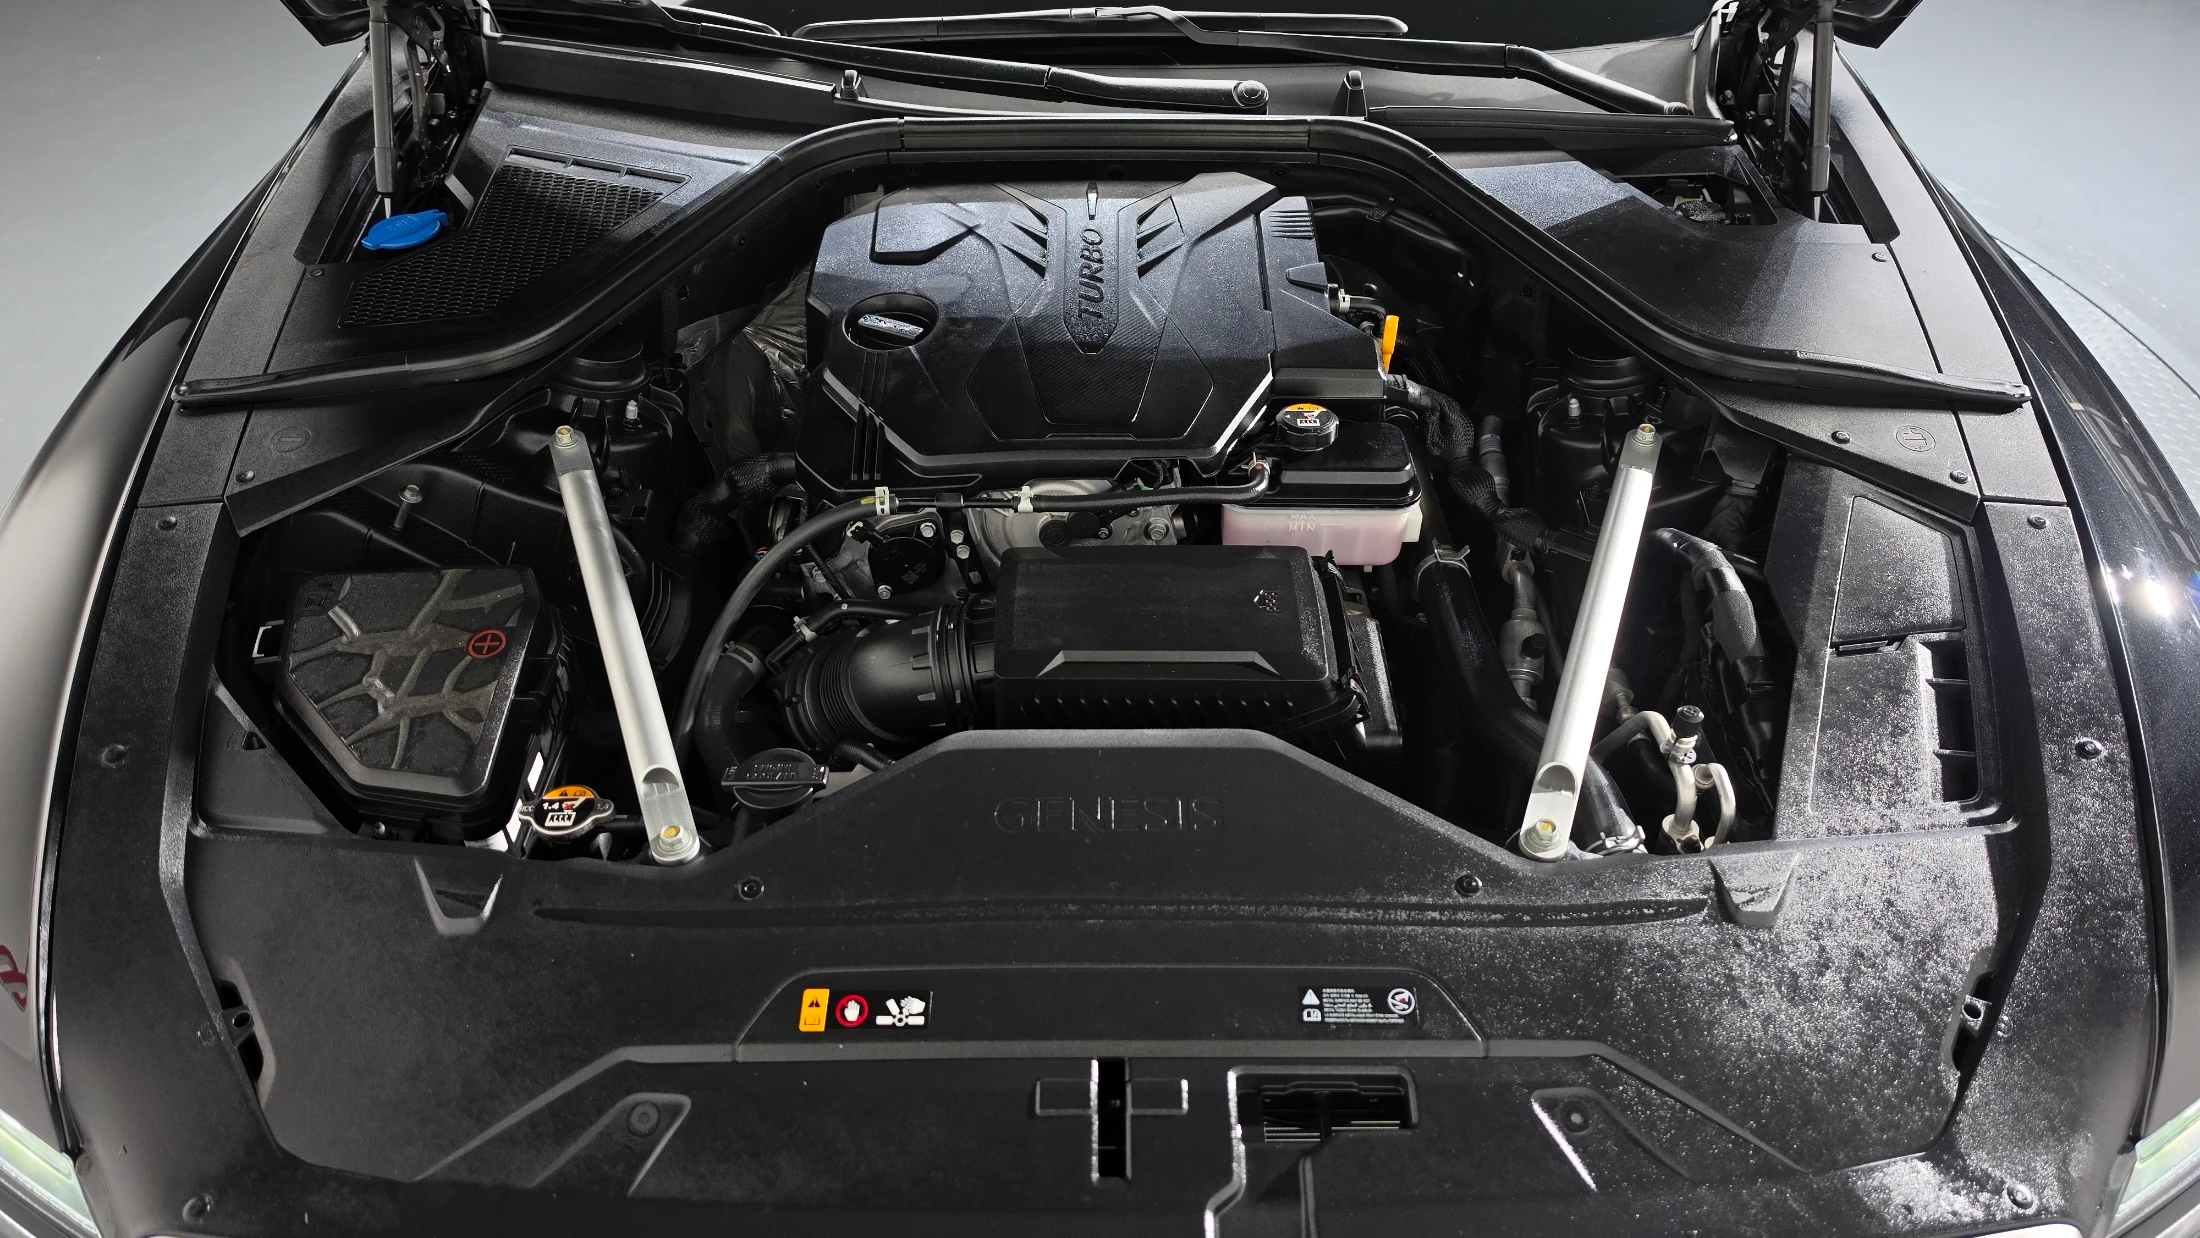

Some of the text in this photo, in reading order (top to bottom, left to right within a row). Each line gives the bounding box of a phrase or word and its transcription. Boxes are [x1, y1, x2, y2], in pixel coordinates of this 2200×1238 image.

[1078, 228, 1105, 319] TURBO
[1290, 513, 1316, 521] MAX
[1288, 522, 1316, 532] MIN
[542, 802, 560, 811] 1.4
[597, 803, 610, 811] 1.4
[994, 796, 1224, 833] GENESIS
